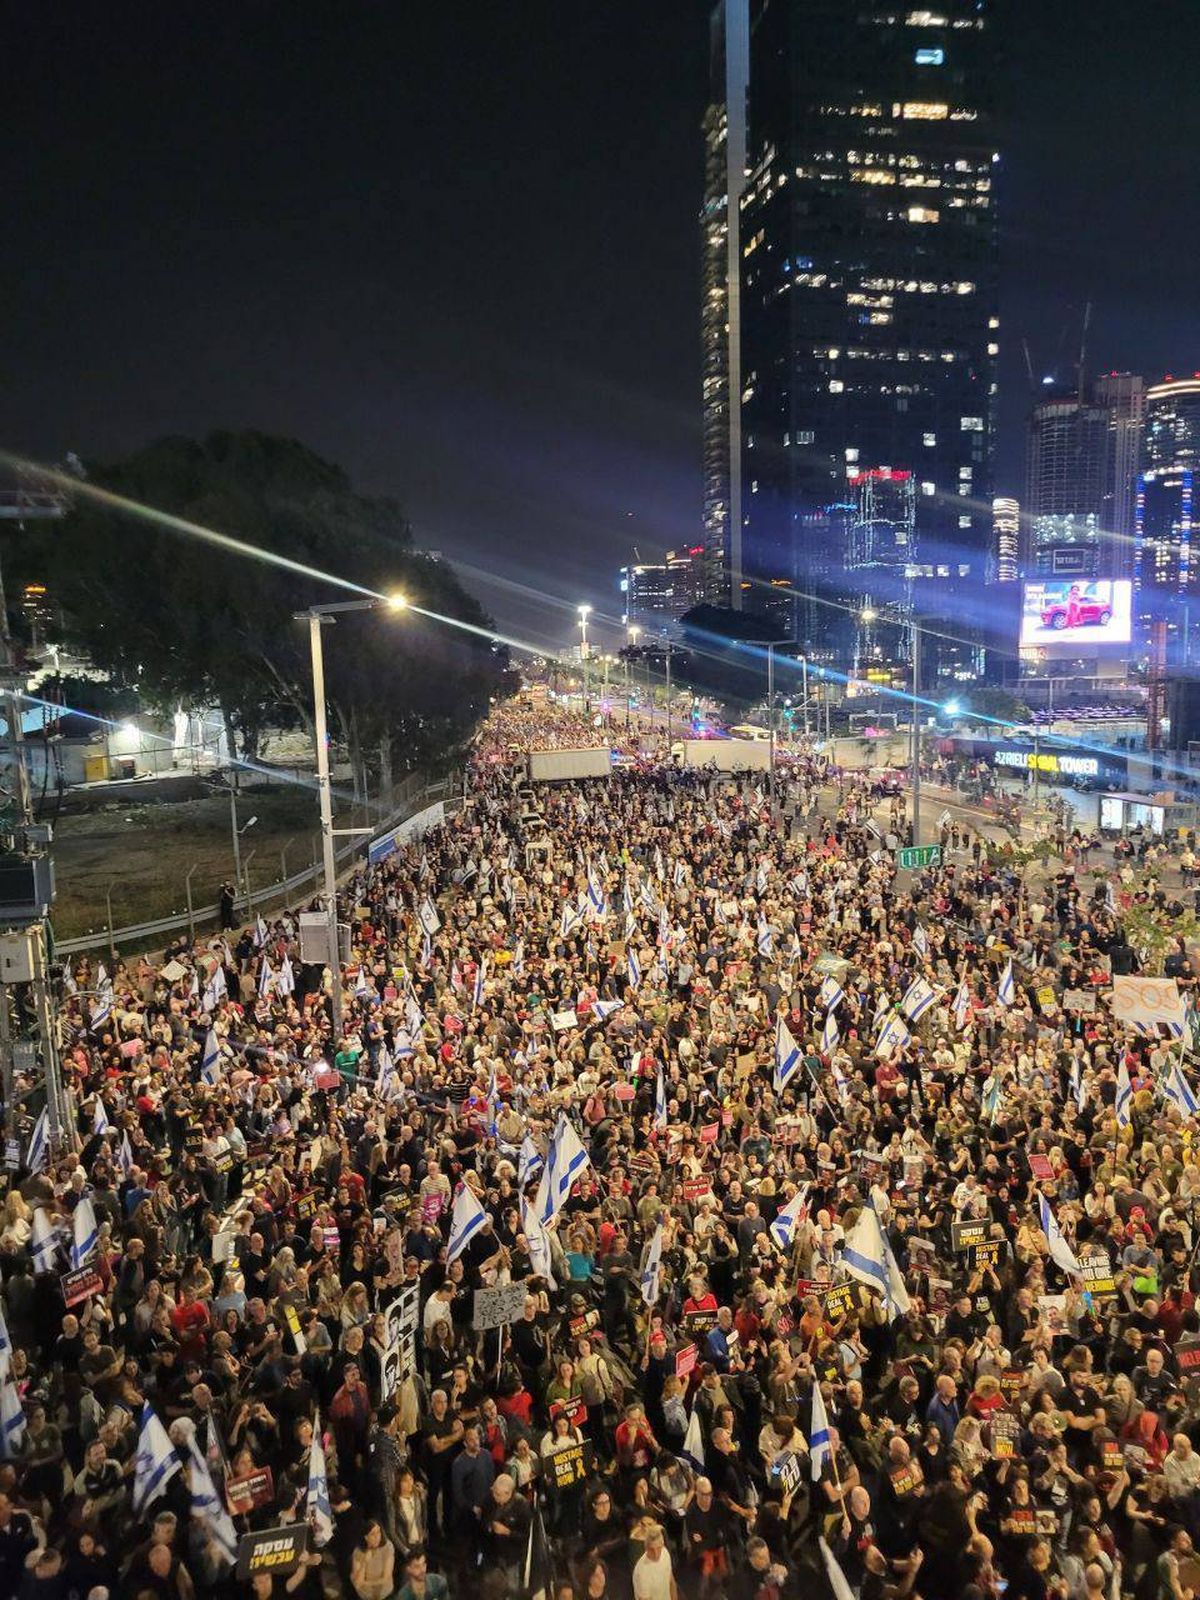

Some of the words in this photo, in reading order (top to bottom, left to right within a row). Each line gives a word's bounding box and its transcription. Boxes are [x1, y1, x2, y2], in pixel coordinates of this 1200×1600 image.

[1058, 757, 1097, 774] TOWER
[1116, 982, 1180, 1010] SOS
[554, 1446, 583, 1466] HOSTAGE
[555, 1462, 573, 1476] DEAL
[557, 1471, 574, 1487] NOW
[253, 1537, 294, 1557] עסקה
